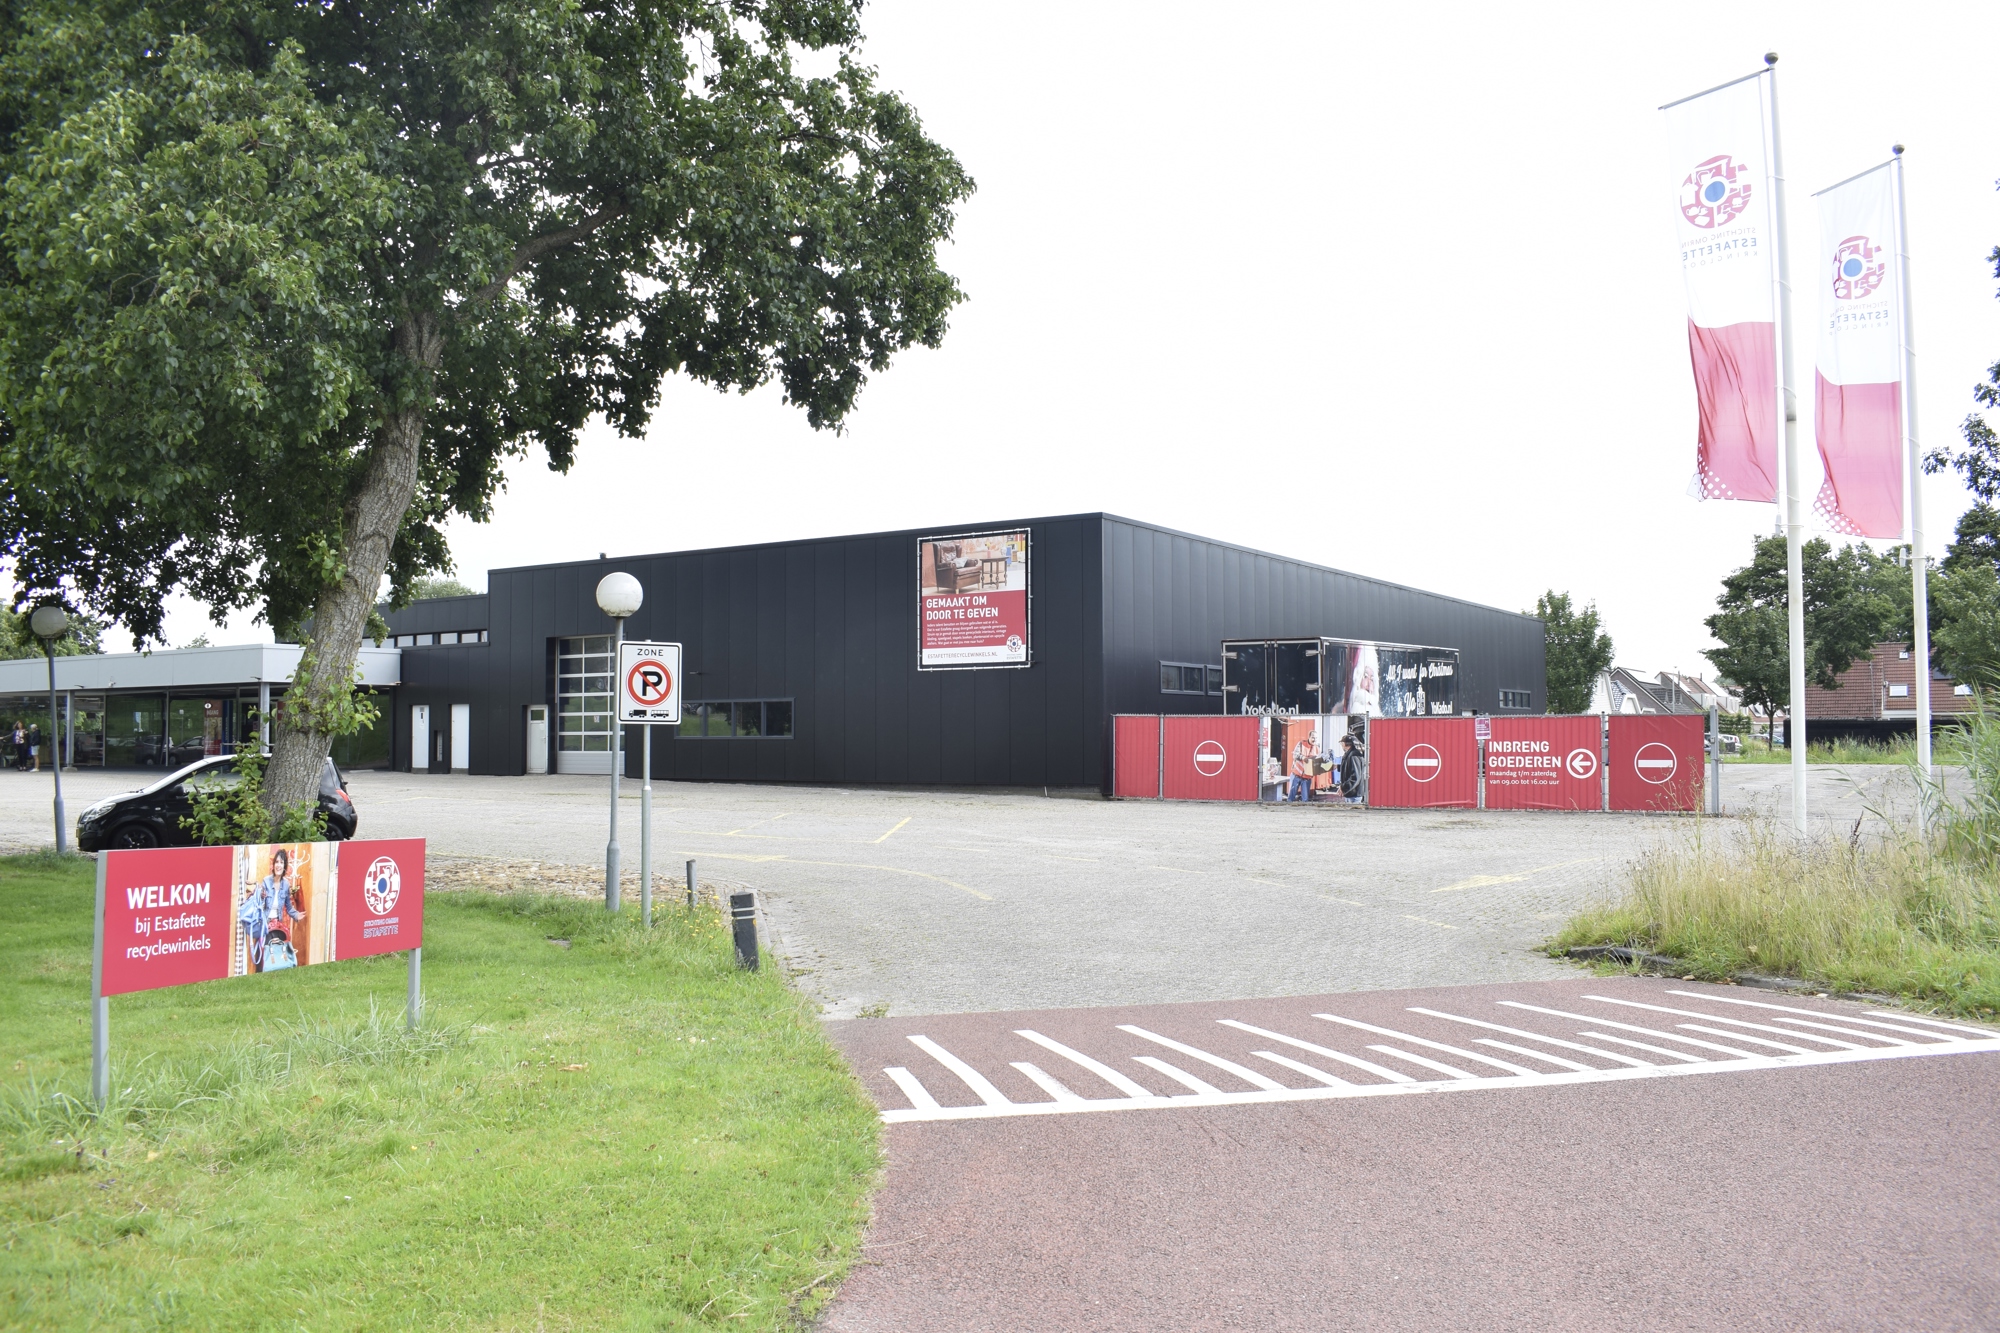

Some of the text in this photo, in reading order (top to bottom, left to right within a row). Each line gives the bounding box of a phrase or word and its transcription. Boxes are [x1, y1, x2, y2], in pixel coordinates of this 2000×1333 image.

[926, 596, 987, 608] GEMAAKT OM
[926, 607, 998, 621] DOOR TE GEVEN
[637, 648, 664, 657] ZONE
[1402, 663, 1418, 680] want
[1419, 662, 1428, 683] for
[1428, 662, 1454, 679] Christmas
[1246, 704, 1299, 716] YoKado.nl
[1431, 700, 1453, 715] YoKado.nl
[1488, 741, 1550, 753] INBRENG
[1488, 756, 1562, 768] GOEDEREN
[1489, 769, 1557, 779] maandag t/m zaterdag
[126, 882, 211, 910] WELKOM
[135, 912, 206, 937] bij Estafette
[363, 924, 399, 939] ESTAFETTE
[126, 933, 211, 962] recyclewinkels
